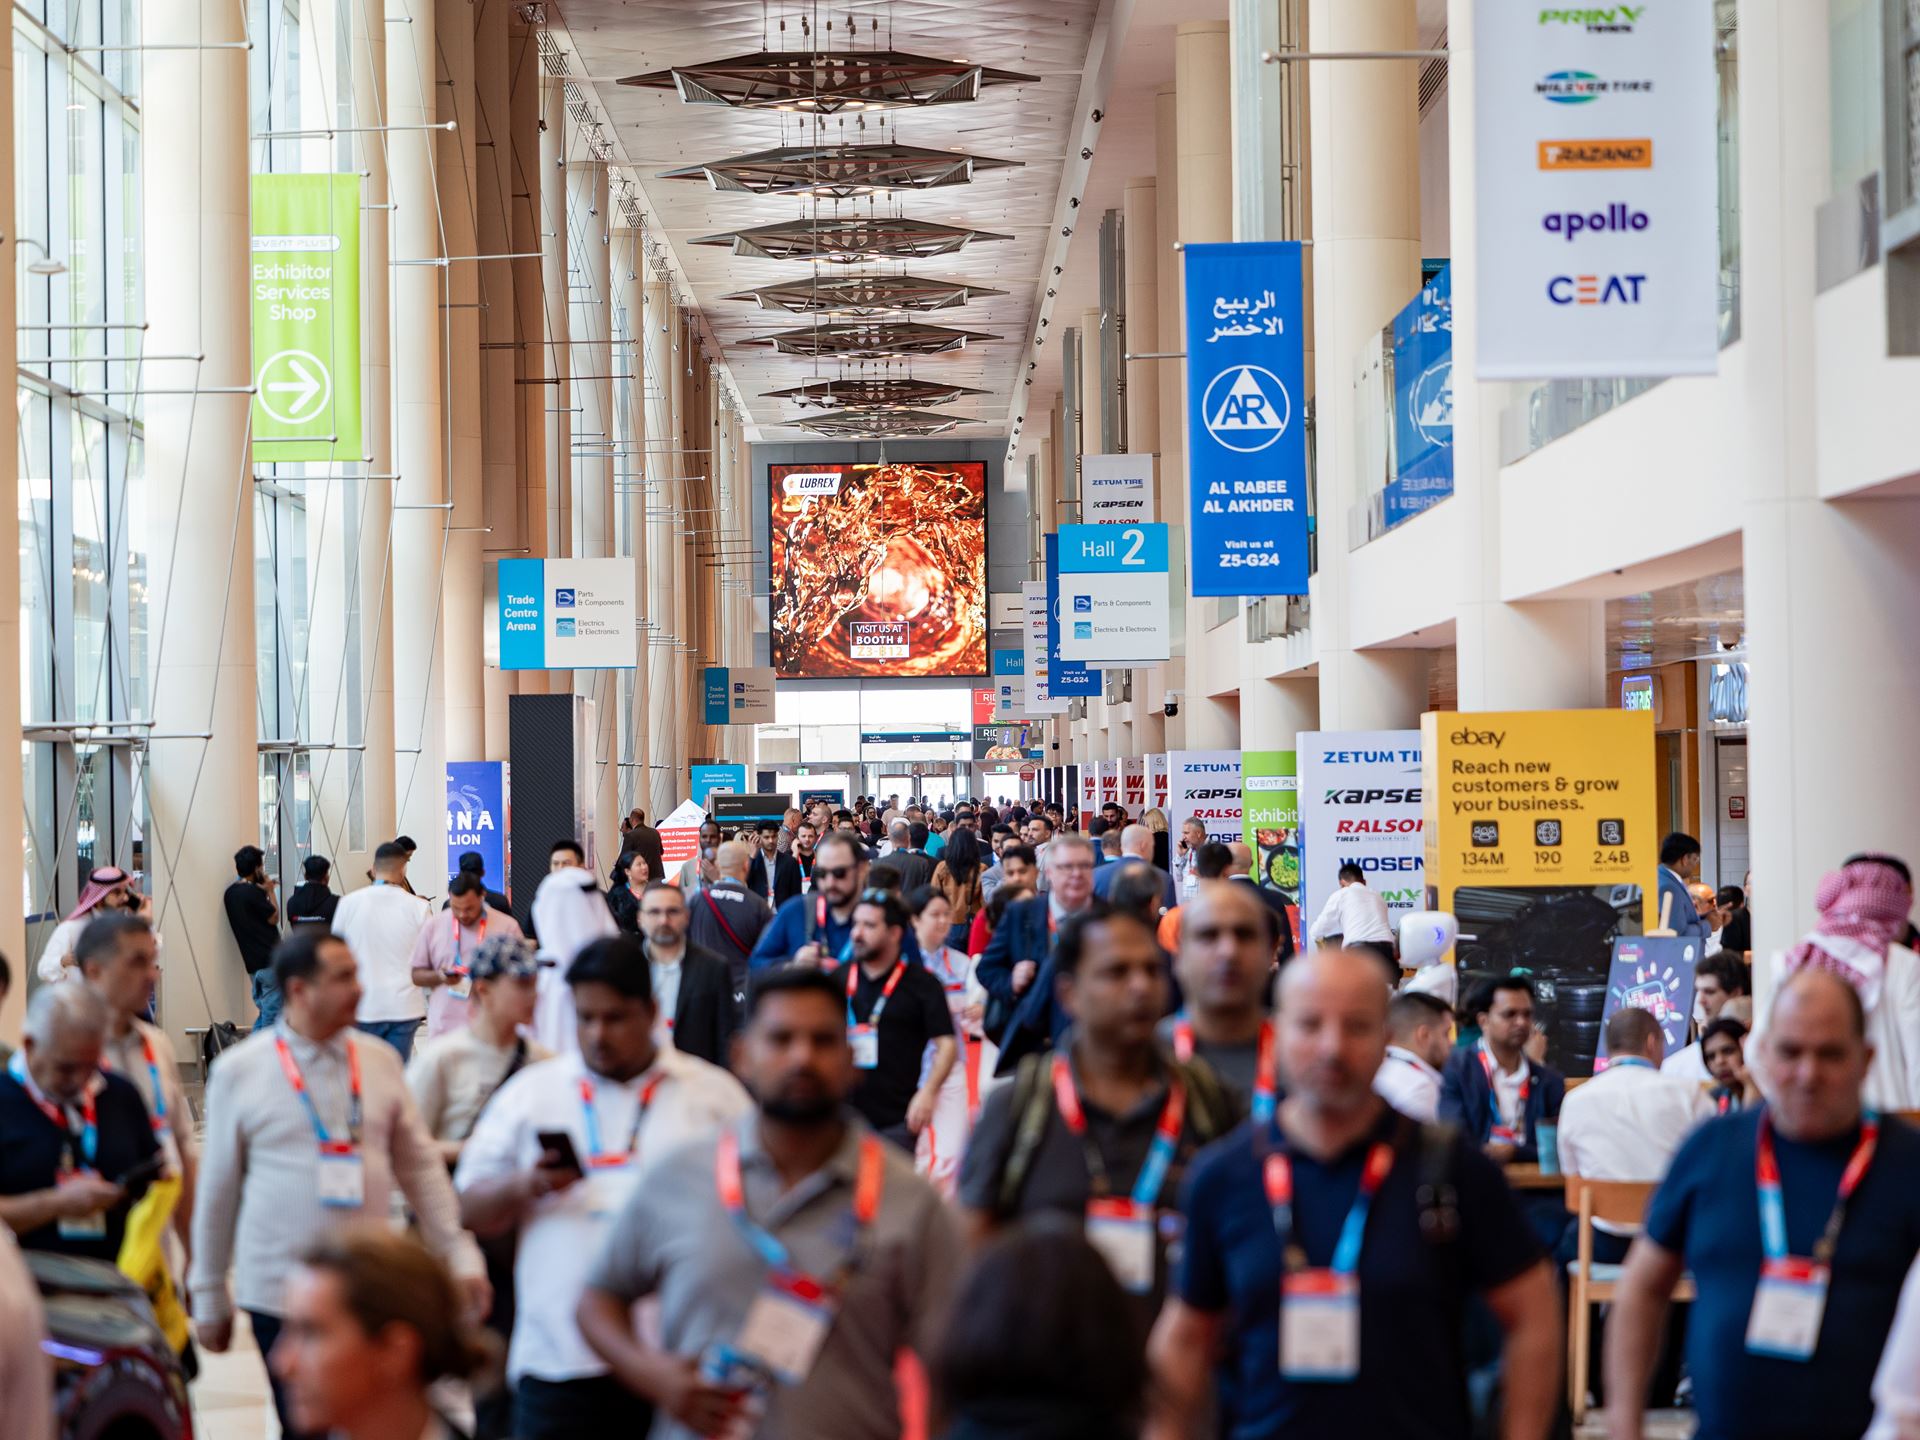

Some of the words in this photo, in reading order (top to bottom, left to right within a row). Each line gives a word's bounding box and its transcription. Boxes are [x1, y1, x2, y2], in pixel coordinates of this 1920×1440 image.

[1546, 146, 1643, 163] TRAZANO
[1543, 203, 1648, 241] apollo
[253, 263, 332, 280] Exhibitor
[255, 284, 331, 301] Services
[1547, 275, 1646, 304] CEAT
[1213, 289, 1276, 319] الربيع
[270, 303, 317, 324] Shop
[1205, 316, 1284, 343] الاخضر
[1220, 393, 1269, 426] AR
[800, 478, 834, 489] LUBREX
[1209, 481, 1231, 495] AL
[1233, 480, 1288, 494] RABEE
[1202, 499, 1224, 513] AL
[1227, 498, 1295, 513] AKHDER
[1082, 540, 1115, 557] Hall
[1121, 529, 1146, 565] 2
[1224, 540, 1248, 549] Visit
[1249, 541, 1262, 549] us
[1263, 540, 1274, 548] at
[1219, 553, 1280, 568] Z5-G24
[506, 594, 535, 605] Trade
[584, 599, 625, 607] Components
[504, 608, 538, 618] Centre
[506, 621, 537, 631] Arena
[856, 624, 878, 633] VISIT
[879, 624, 891, 633] US
[892, 624, 904, 633] AT
[856, 635, 894, 645] BOOTH
[897, 635, 904, 644] #
[1005, 658, 1024, 667] Hall
[1060, 676, 1089, 684] Z5-G24
[1450, 727, 1506, 749] ebay
[1323, 751, 1394, 764] ZETUM
[1184, 763, 1231, 773] ZETUM
[1452, 759, 1509, 775] Reach
[1514, 761, 1551, 773] new
[1248, 779, 1279, 787] EVENT
[1452, 778, 1550, 793] customers
[1555, 776, 1569, 792] &
[1574, 779, 1619, 795] grow
[1452, 799, 1493, 815] your
[1497, 796, 1584, 811] business.
[1193, 808, 1243, 818] RALSO
[1249, 808, 1298, 822] Exhibit
[448, 833, 481, 846] LION
[1462, 852, 1504, 865] 134M
[1534, 851, 1562, 864] 190
[1593, 850, 1630, 864] 2.4B
